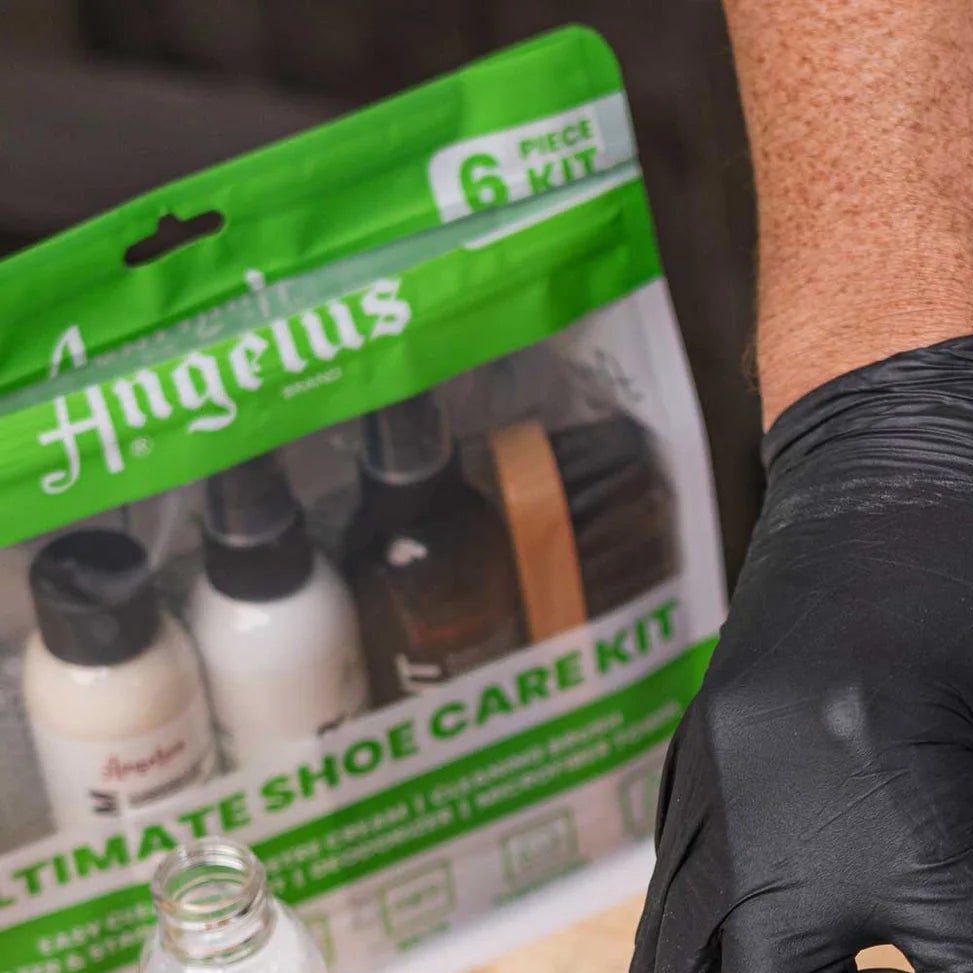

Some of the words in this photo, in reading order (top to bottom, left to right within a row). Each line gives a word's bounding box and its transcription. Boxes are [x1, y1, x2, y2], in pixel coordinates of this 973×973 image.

[519, 119, 592, 159] PIECE
[458, 152, 510, 214] 6
[527, 146, 598, 196] KIT
[38, 272, 413, 494] Angelus
[260, 718, 420, 814] SHOE
[430, 650, 585, 740] CARE
[594, 597, 681, 677] KIT
